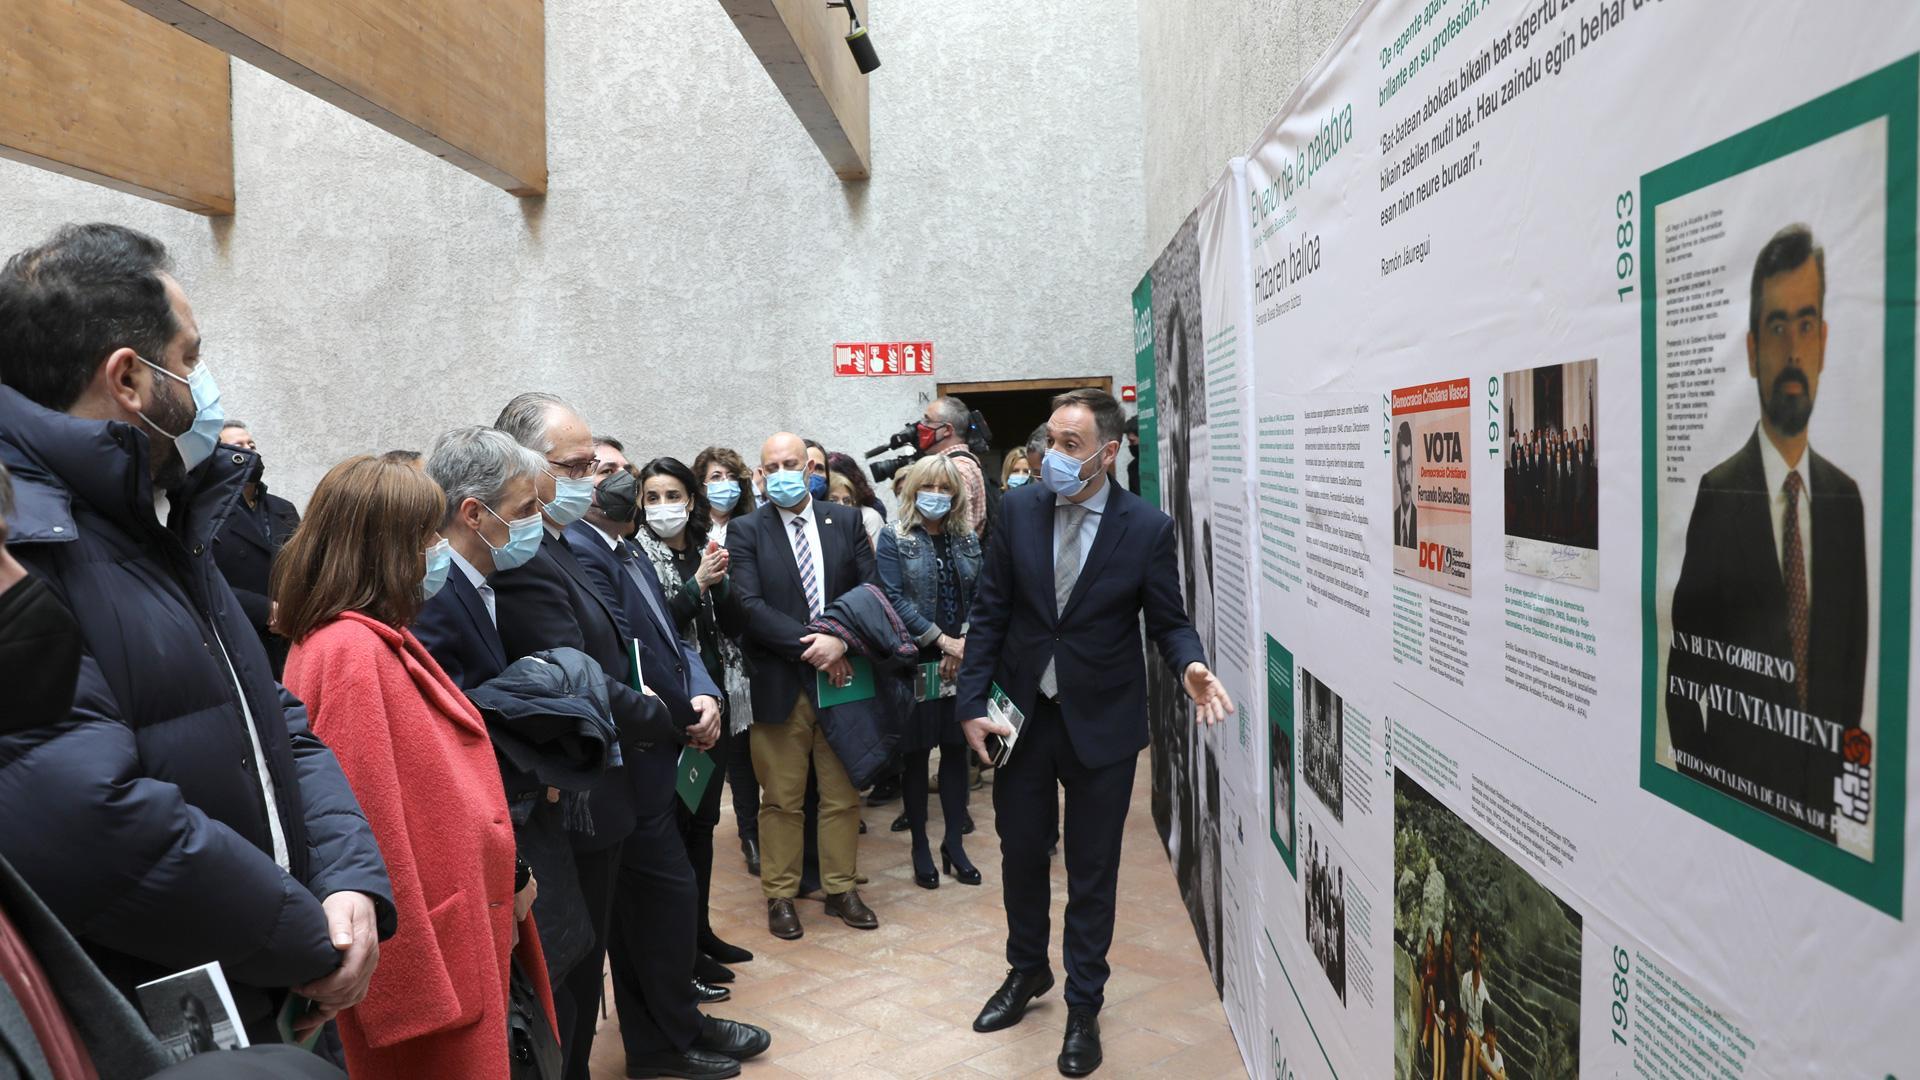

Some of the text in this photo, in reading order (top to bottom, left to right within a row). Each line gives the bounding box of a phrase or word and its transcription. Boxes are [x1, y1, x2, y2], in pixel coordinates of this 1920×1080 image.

[1380, 66, 1407, 107] brillante
[1409, 55, 1419, 80] en
[1420, 43, 1431, 68] su
[1432, 0, 1479, 63] profesión.
[1393, 13, 1422, 58] repente
[1422, 79, 1458, 123] abokatu
[1460, 50, 1491, 92] bikain
[1494, 33, 1512, 66] bat
[1515, 0, 1556, 50] agertu
[1380, 0, 1624, 192] bikain zebilen mutil bat. Hau zaindu egin behar
[1259, 174, 1280, 220] valor
[1282, 157, 1293, 201] de
[1296, 145, 1305, 189] la
[1307, 104, 1352, 189] palabra
[1380, 205, 1397, 226] esan
[1398, 190, 1414, 216] nion
[1416, 174, 1440, 204] neure
[1255, 233, 1320, 304] Hitzaren balioa
[1381, 234, 1431, 277] Ramón Jáuregui
[1616, 190, 1634, 302] 1983
[1392, 383, 1468, 409] Democracia Cristiana Vasca
[1488, 376, 1499, 460] 1979
[1421, 466, 1467, 479] Democracia Cristiana
[1423, 431, 1463, 463] VOTA
[1418, 485, 1470, 506] Fernando Buesa Blanco
[1419, 541, 1444, 572] DCV
[1671, 630, 1796, 683] UN BUEN GOBIERNO
[1670, 675, 1686, 696] EN
[1688, 680, 1704, 704] TU
[1668, 745, 1703, 771] PARTIDO
[1704, 762, 1758, 799] SOCIALISTA
[1761, 786, 1774, 806] DE
[1612, 945, 1629, 1046] 1986
